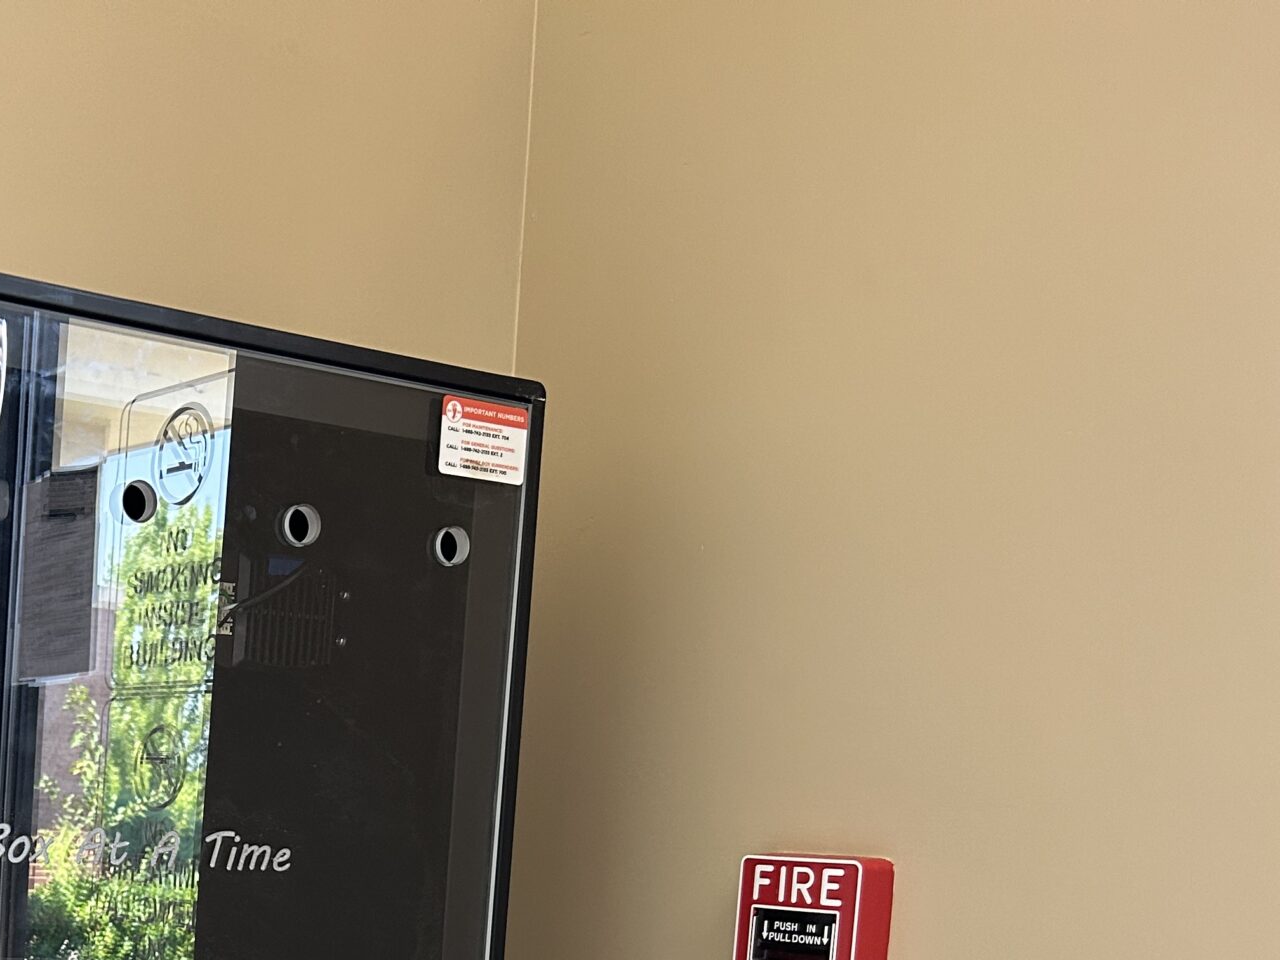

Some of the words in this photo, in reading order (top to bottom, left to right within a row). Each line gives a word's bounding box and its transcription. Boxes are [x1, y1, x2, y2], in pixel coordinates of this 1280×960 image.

[464, 406, 497, 417] IMPORTANT
[497, 412, 525, 423] NUMBERS
[76, 827, 130, 871] At
[151, 830, 180, 872] A
[205, 829, 291, 872] Time
[753, 864, 845, 907] FIRE
[774, 921, 798, 931] PUSH
[806, 924, 816, 933] IN
[768, 932, 791, 942] PULL
[792, 935, 821, 945] DOWN
